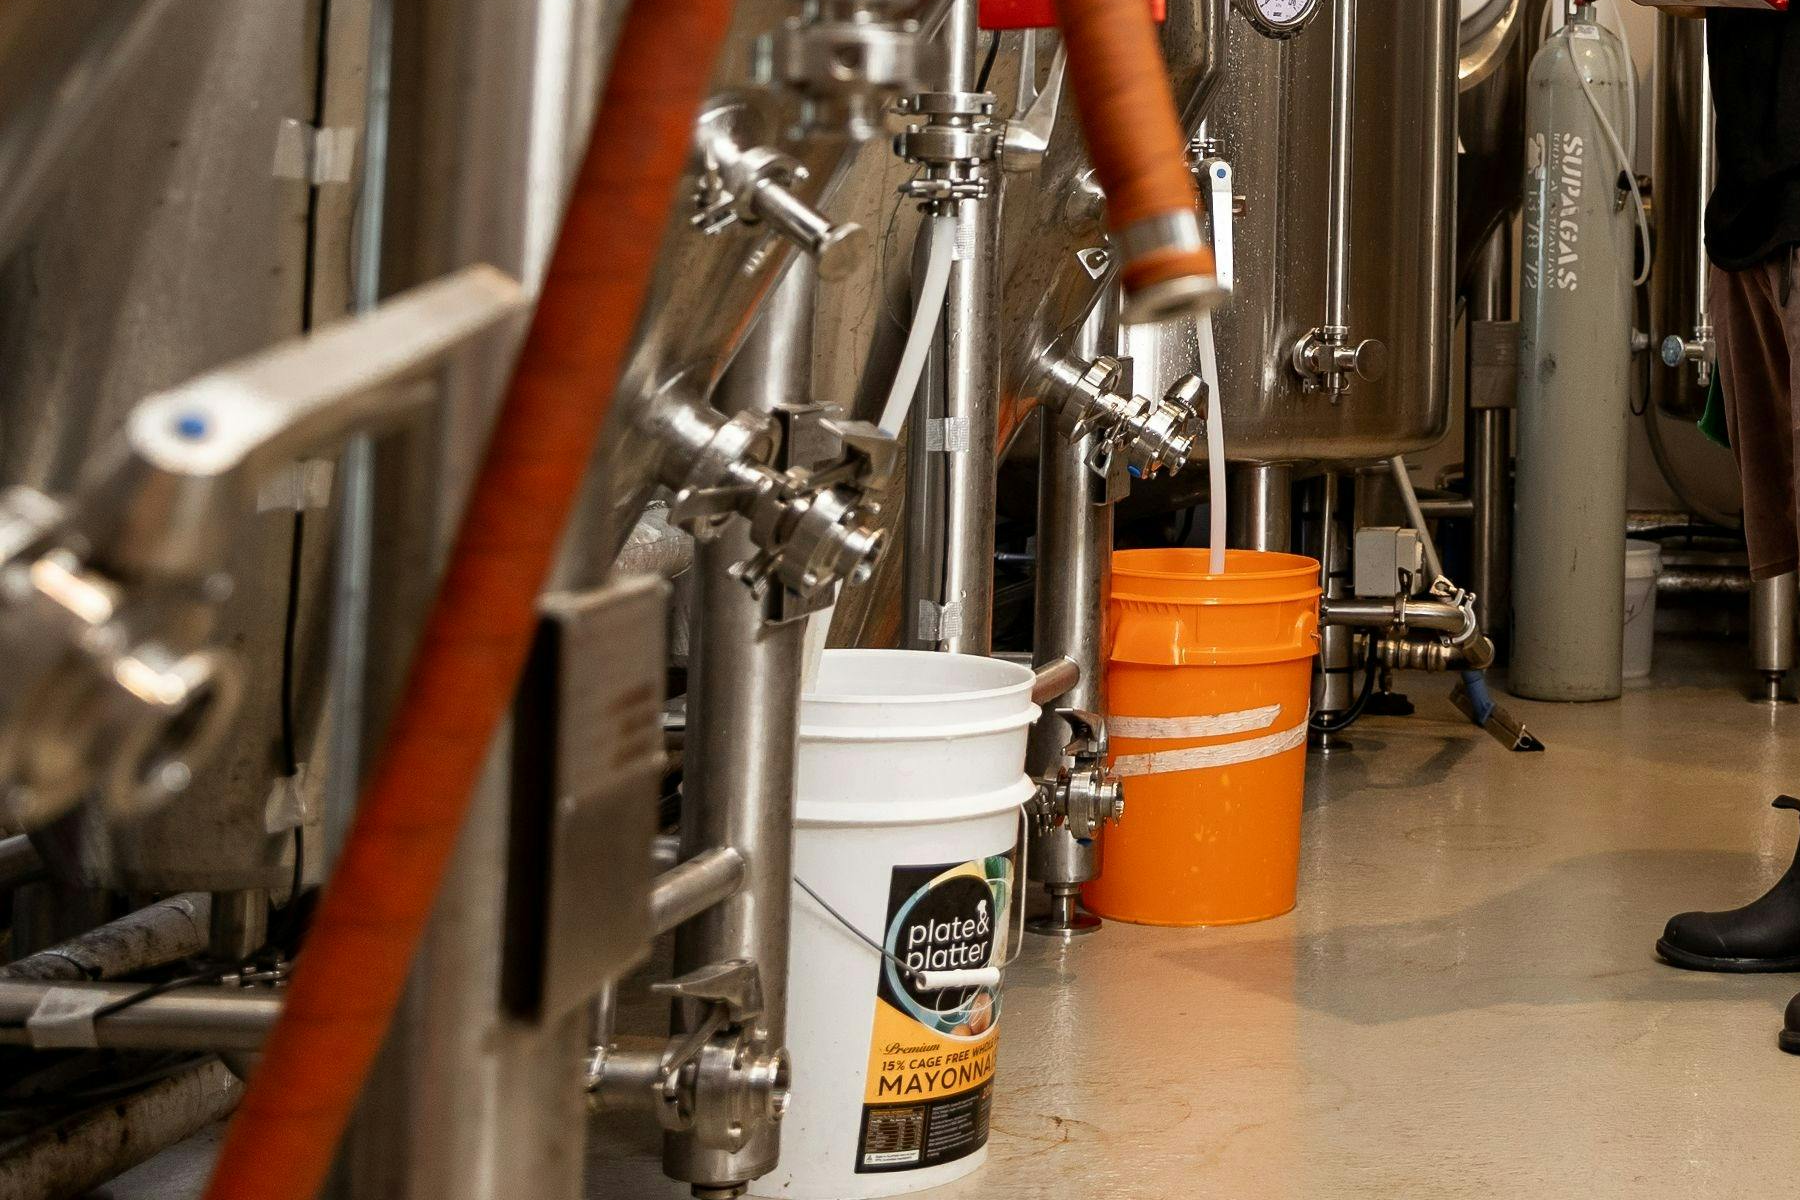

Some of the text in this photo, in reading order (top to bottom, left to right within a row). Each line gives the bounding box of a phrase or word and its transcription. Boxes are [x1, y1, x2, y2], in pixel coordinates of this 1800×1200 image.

[1557, 133, 1583, 291] SUPAGAS
[905, 941, 988, 976] platter
[882, 1060, 905, 1071] 15%
[909, 1056, 942, 1070] CAGE
[945, 1049, 970, 1065] FREE
[883, 1043, 940, 1055] Premium
